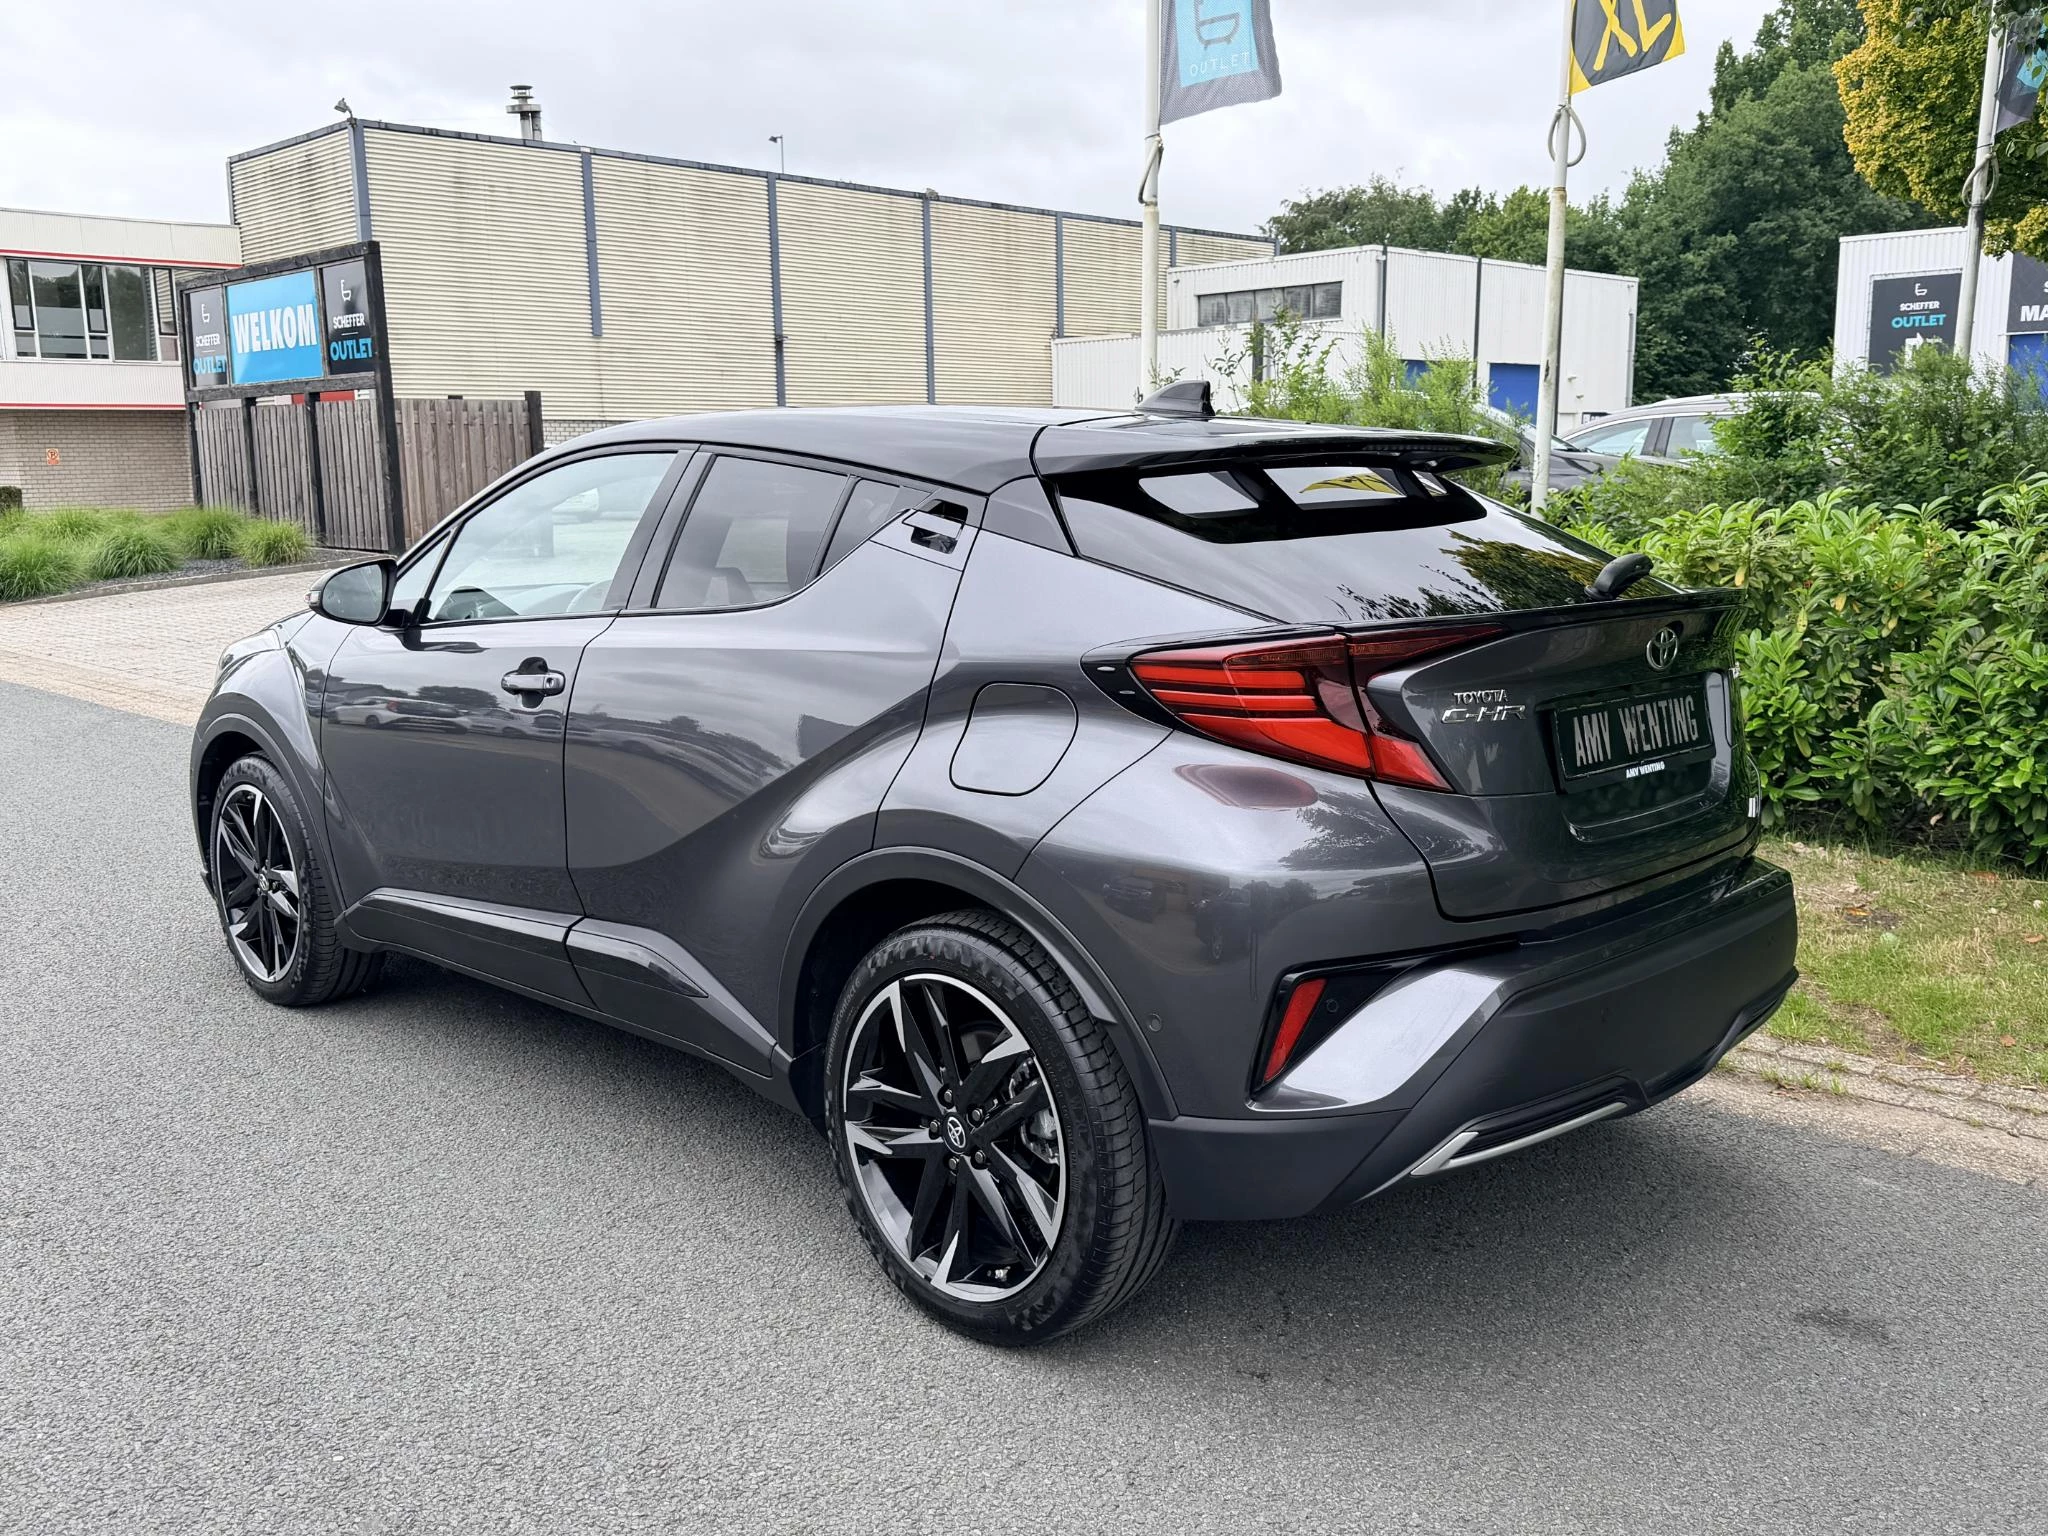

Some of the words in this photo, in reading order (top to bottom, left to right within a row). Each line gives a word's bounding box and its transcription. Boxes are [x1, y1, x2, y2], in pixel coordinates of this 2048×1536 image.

[1593, 0, 1672, 71] XL
[1190, 52, 1250, 77] OUTLET
[1899, 300, 1940, 312] SCHEFFER
[232, 303, 317, 354] WELKOM
[333, 312, 365, 329] SCHEFFER
[1891, 313, 1946, 329] OUTLET
[195, 333, 220, 347] SCHEFFER
[330, 337, 373, 361] OUTLET
[193, 355, 226, 375] OUTLET
[1453, 689, 1508, 704] TOYOTA
[1441, 705, 1526, 724] C-HR
[1573, 711, 1613, 767] AMV
[1617, 695, 1699, 755] WENTING
[1639, 760, 1666, 775] WENTING
